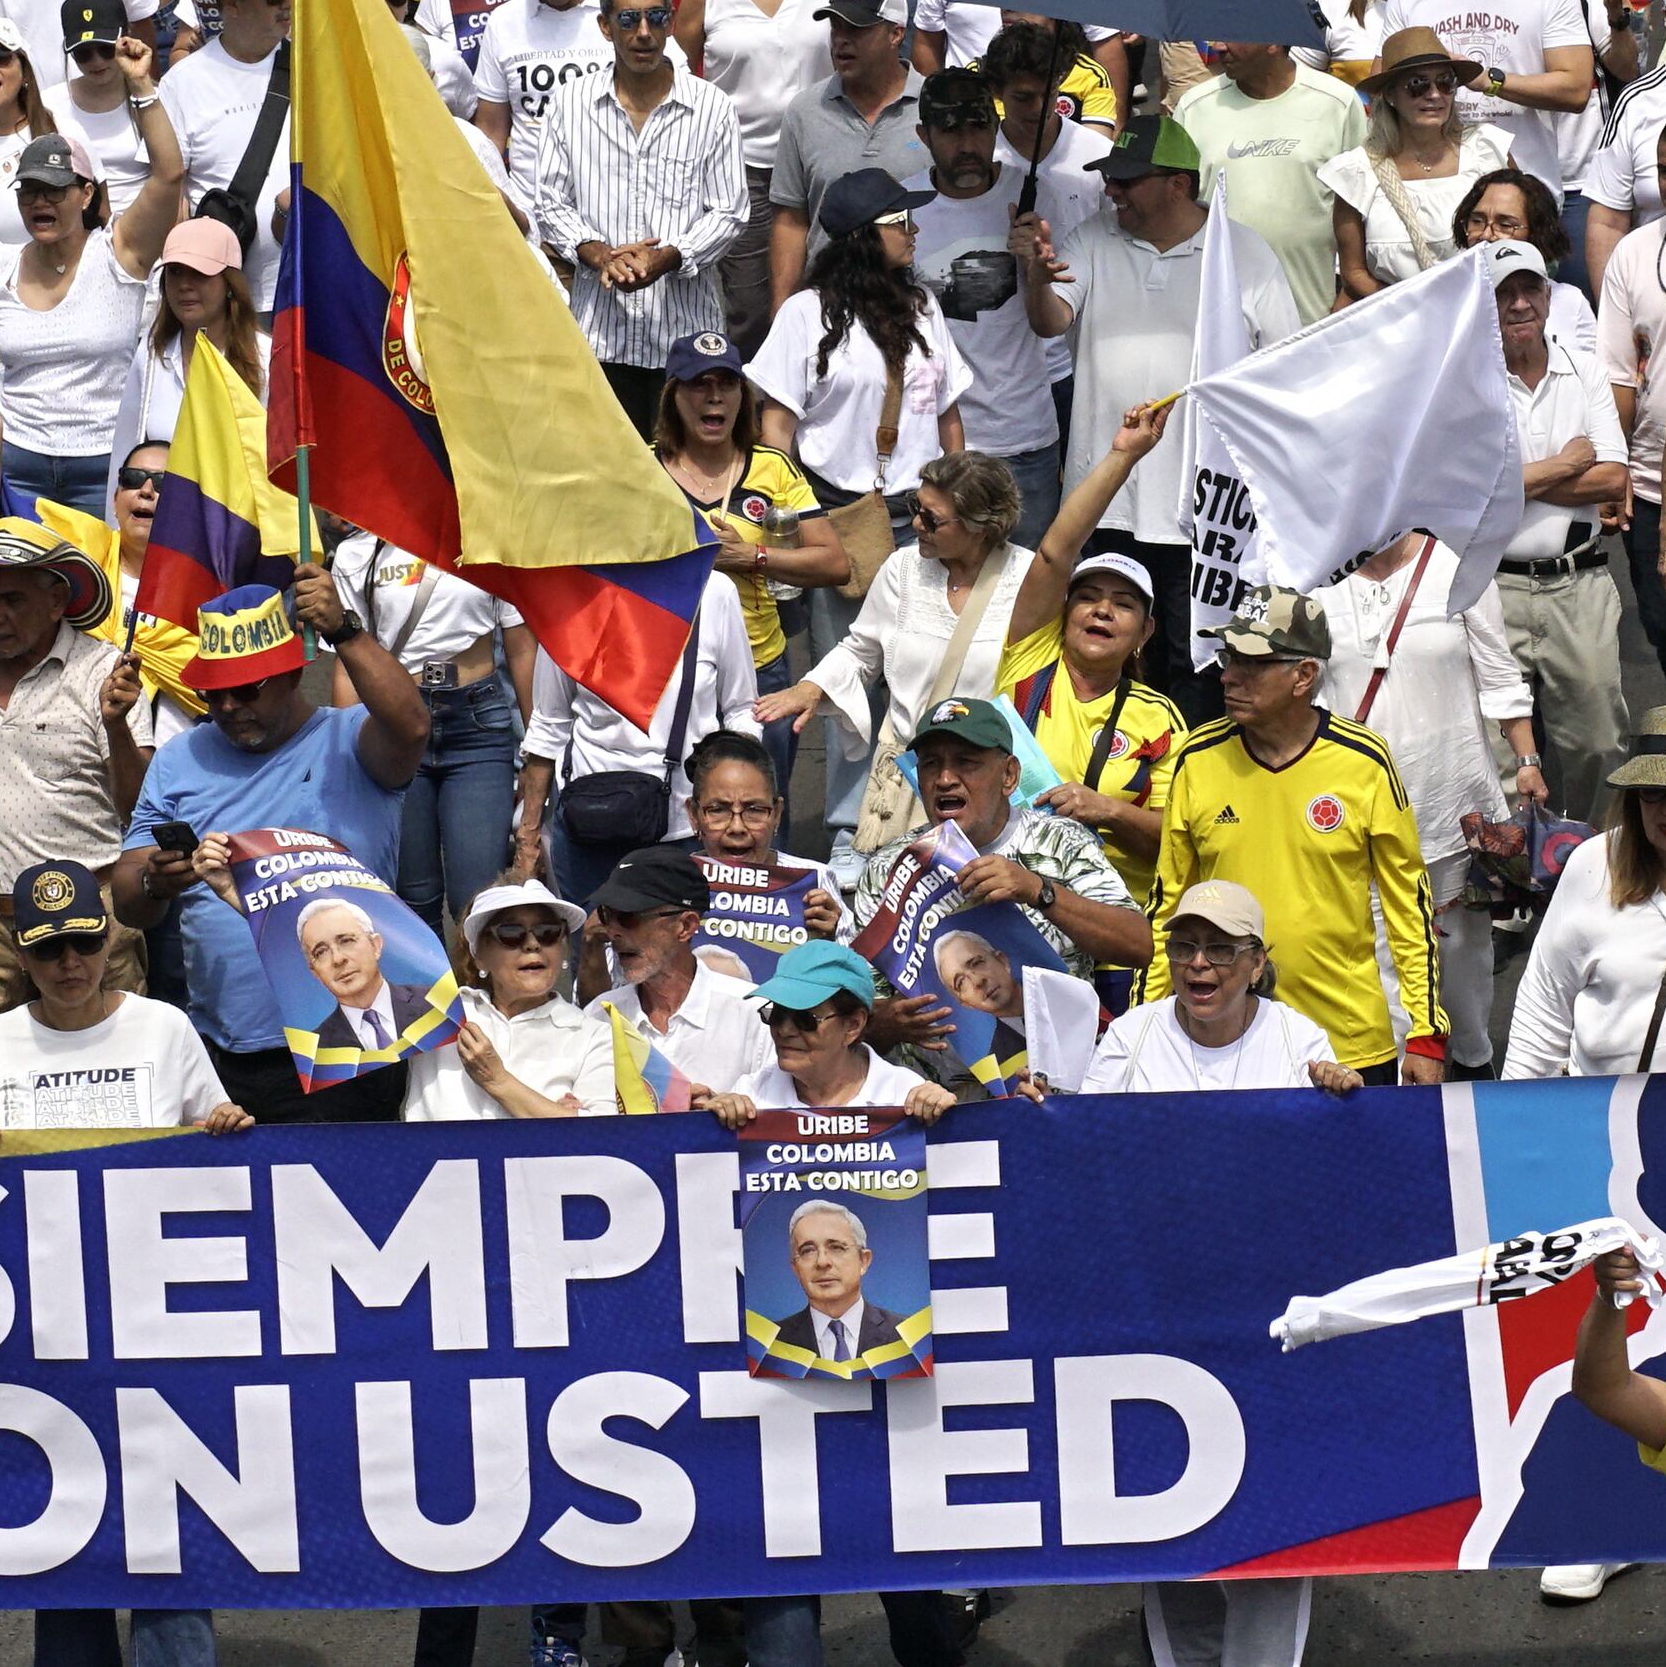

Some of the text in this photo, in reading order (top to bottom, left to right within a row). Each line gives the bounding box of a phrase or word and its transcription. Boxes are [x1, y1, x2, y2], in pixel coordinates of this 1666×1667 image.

[1466, 13, 1492, 28] AND
[1494, 15, 1519, 35] DRY
[460, 34, 483, 53] EST
[513, 49, 565, 64] LIBERTAD
[576, 48, 609, 60] ORDE
[1237, 140, 1301, 158] NIKE
[388, 338, 435, 410] DE COLO
[1190, 468, 1257, 534] STIC
[200, 611, 290, 655] COLOMBIA
[273, 827, 337, 850] URIBE
[254, 851, 367, 880] COLOMBIA
[703, 862, 771, 890] URIBE
[884, 852, 921, 916] URIBE
[244, 882, 298, 916] ESTA
[710, 891, 791, 917] OMBIA
[893, 863, 958, 956] COLOMBIA
[704, 917, 809, 946] CONTIGO
[896, 887, 967, 991] ESTA CONTI
[797, 1114, 871, 1137] URIBE
[766, 1141, 897, 1165] COLOMBIA
[746, 1168, 920, 1193] ESTA CONTIGO
[355, 1353, 1247, 1575] USTED
